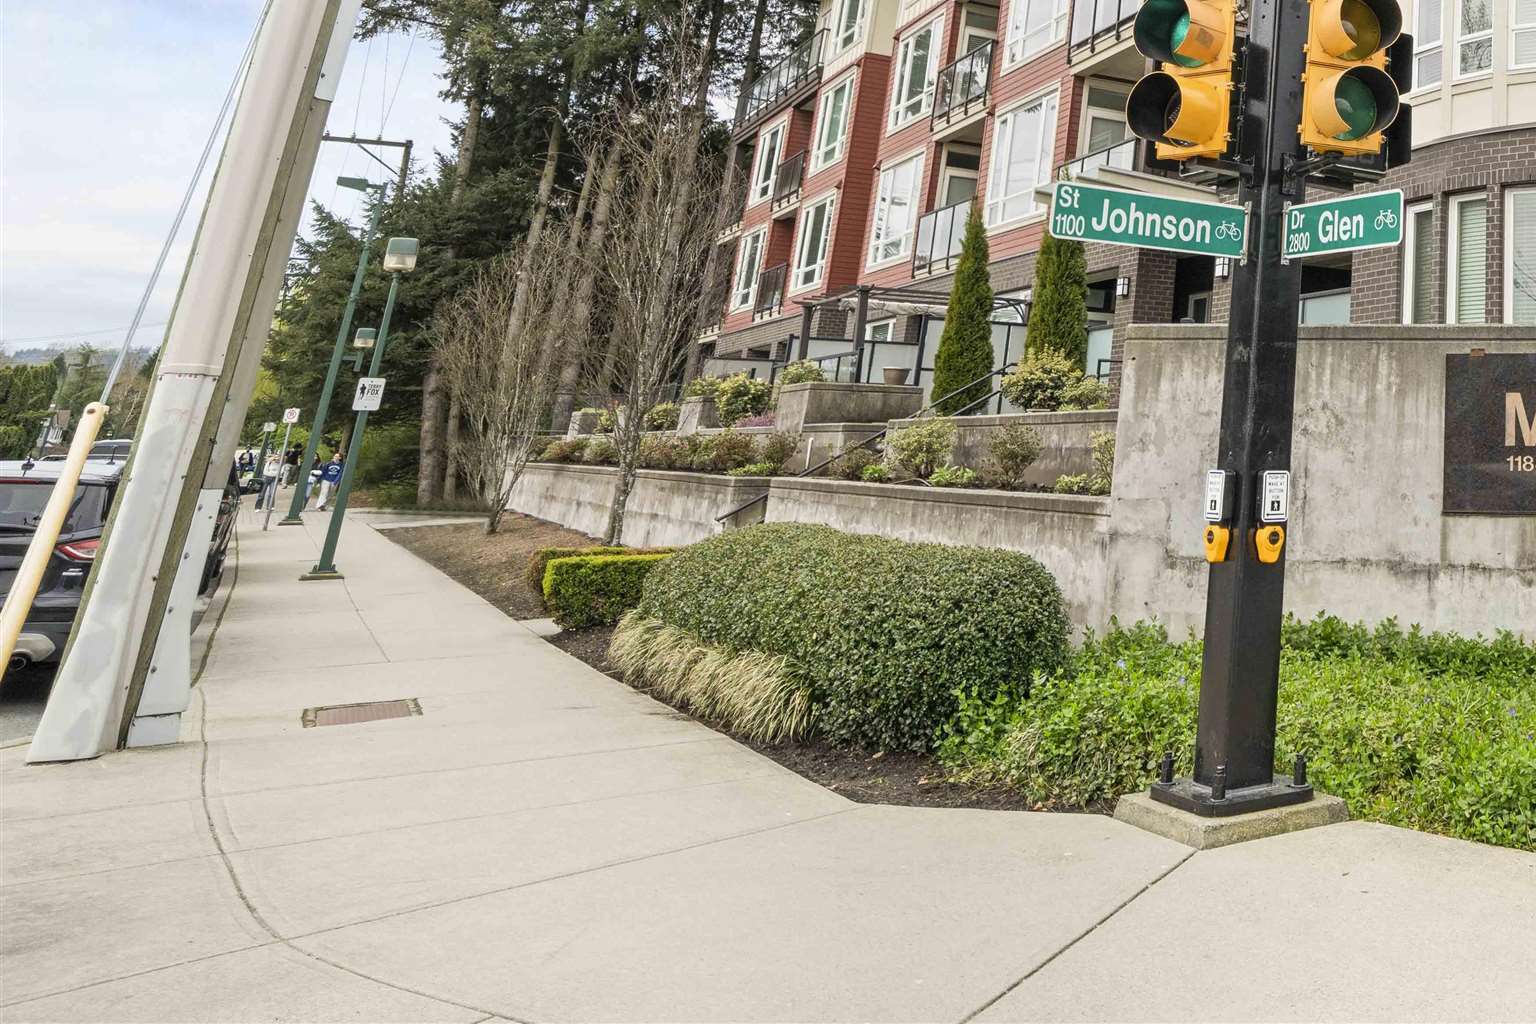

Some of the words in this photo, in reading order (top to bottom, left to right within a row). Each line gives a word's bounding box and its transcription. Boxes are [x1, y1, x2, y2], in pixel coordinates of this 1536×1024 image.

[1058, 185, 1080, 209] St
[1055, 214, 1085, 238] 1100
[1091, 198, 1211, 244] Johnson
[1290, 209, 1306, 229] Dr
[1318, 209, 1364, 244] Glen
[1288, 231, 1311, 254] 2800
[366, 388, 379, 396] FOX
